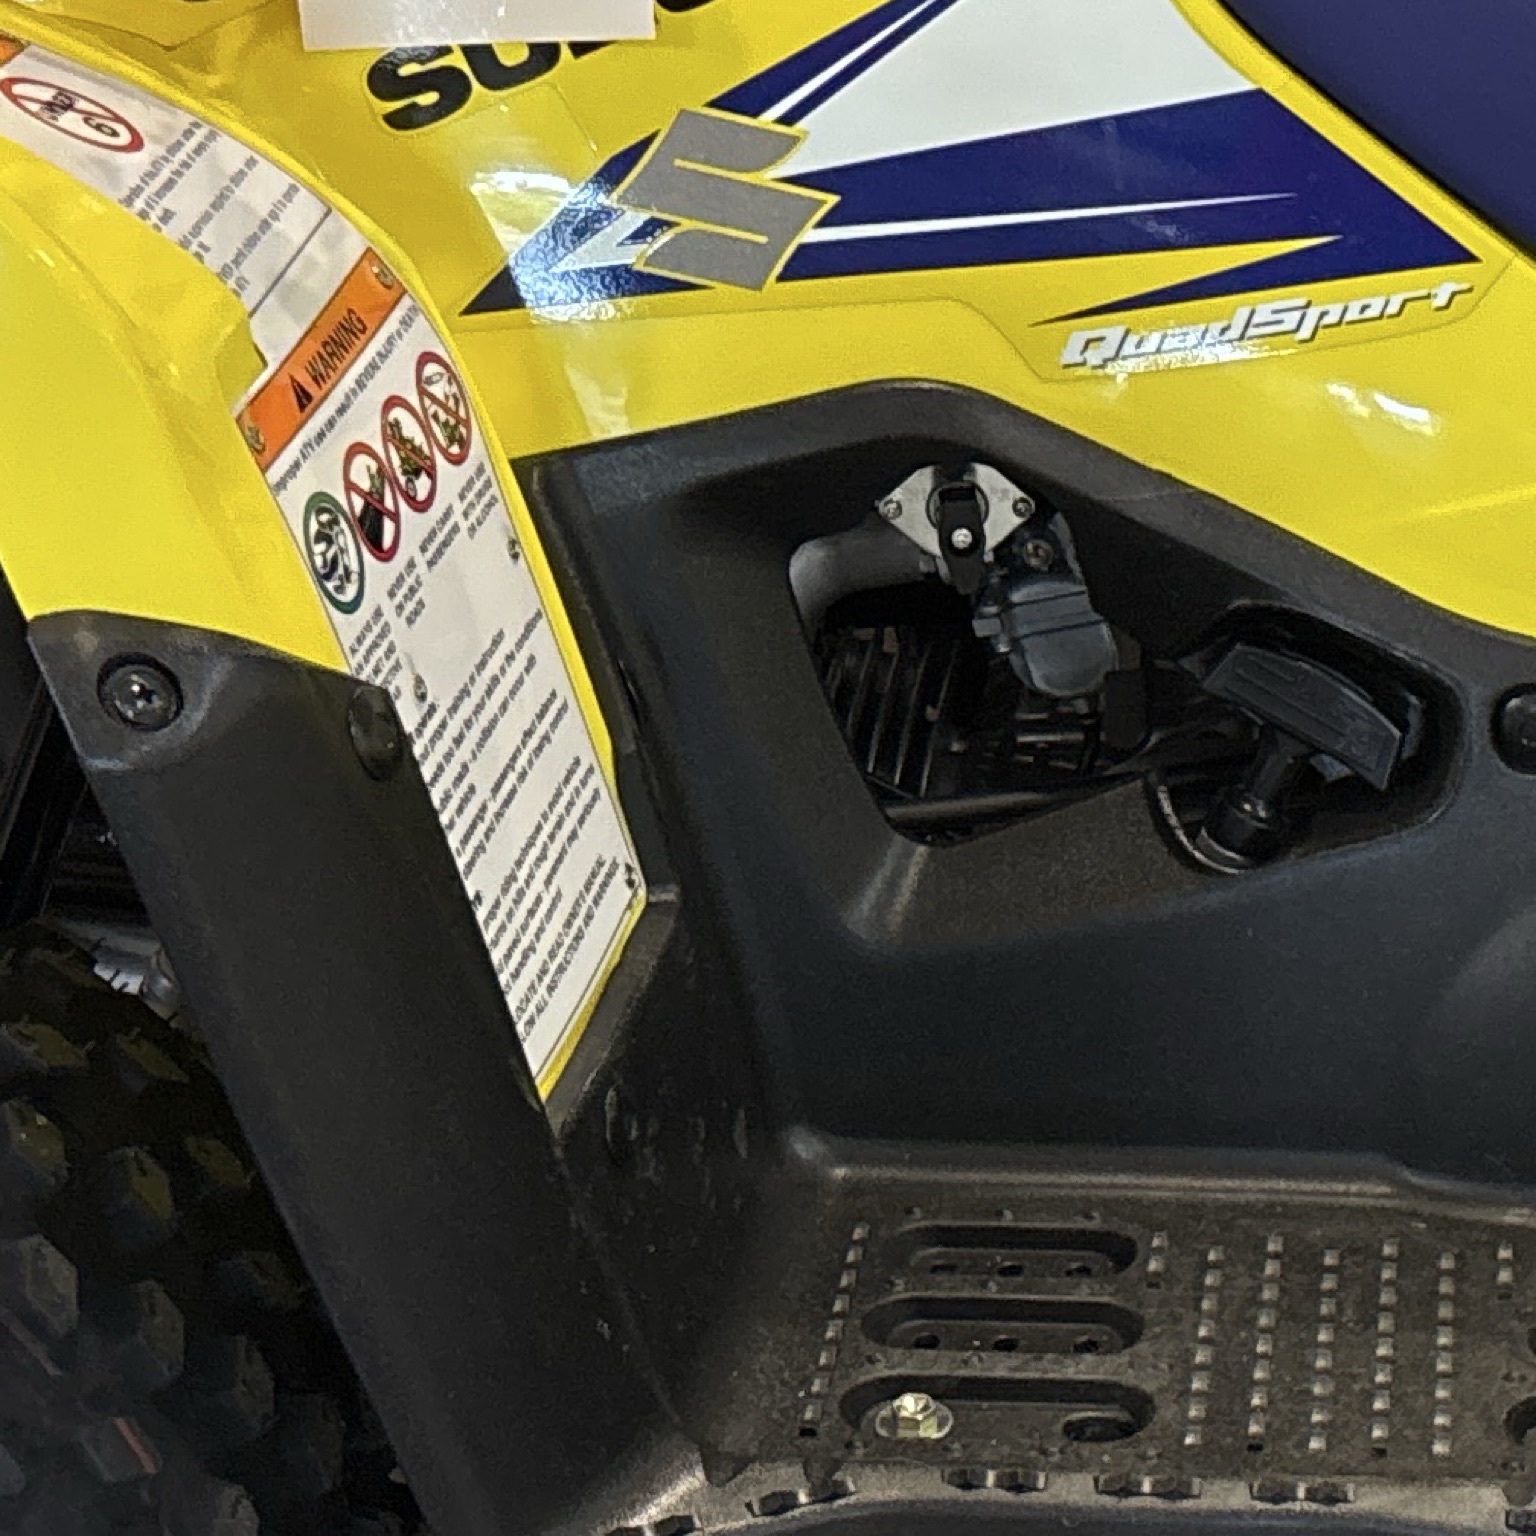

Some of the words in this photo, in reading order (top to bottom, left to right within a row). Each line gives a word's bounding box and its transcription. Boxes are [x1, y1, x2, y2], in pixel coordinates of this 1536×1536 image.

[84, 116, 120, 138] 6
[305, 308, 366, 388] WARNING
[1058, 278, 1474, 371] QuadSport
